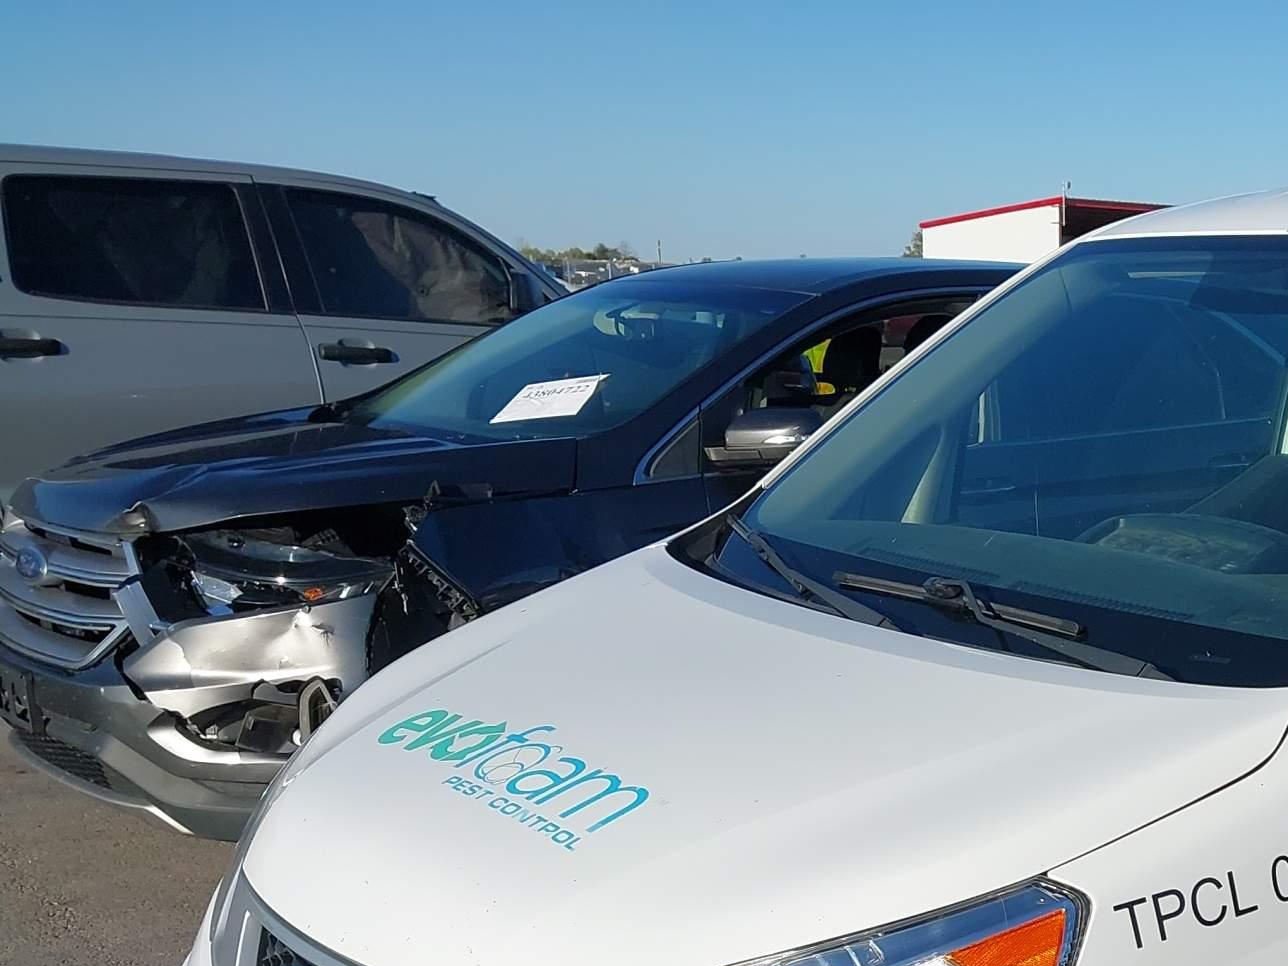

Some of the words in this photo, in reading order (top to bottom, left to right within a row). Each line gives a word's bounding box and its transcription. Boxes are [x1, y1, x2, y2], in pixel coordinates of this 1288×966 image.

[377, 709, 650, 833] evofoam
[441, 776, 494, 799] PEST
[488, 797, 582, 850] CONTROL
[1113, 871, 1258, 949] TPCL
